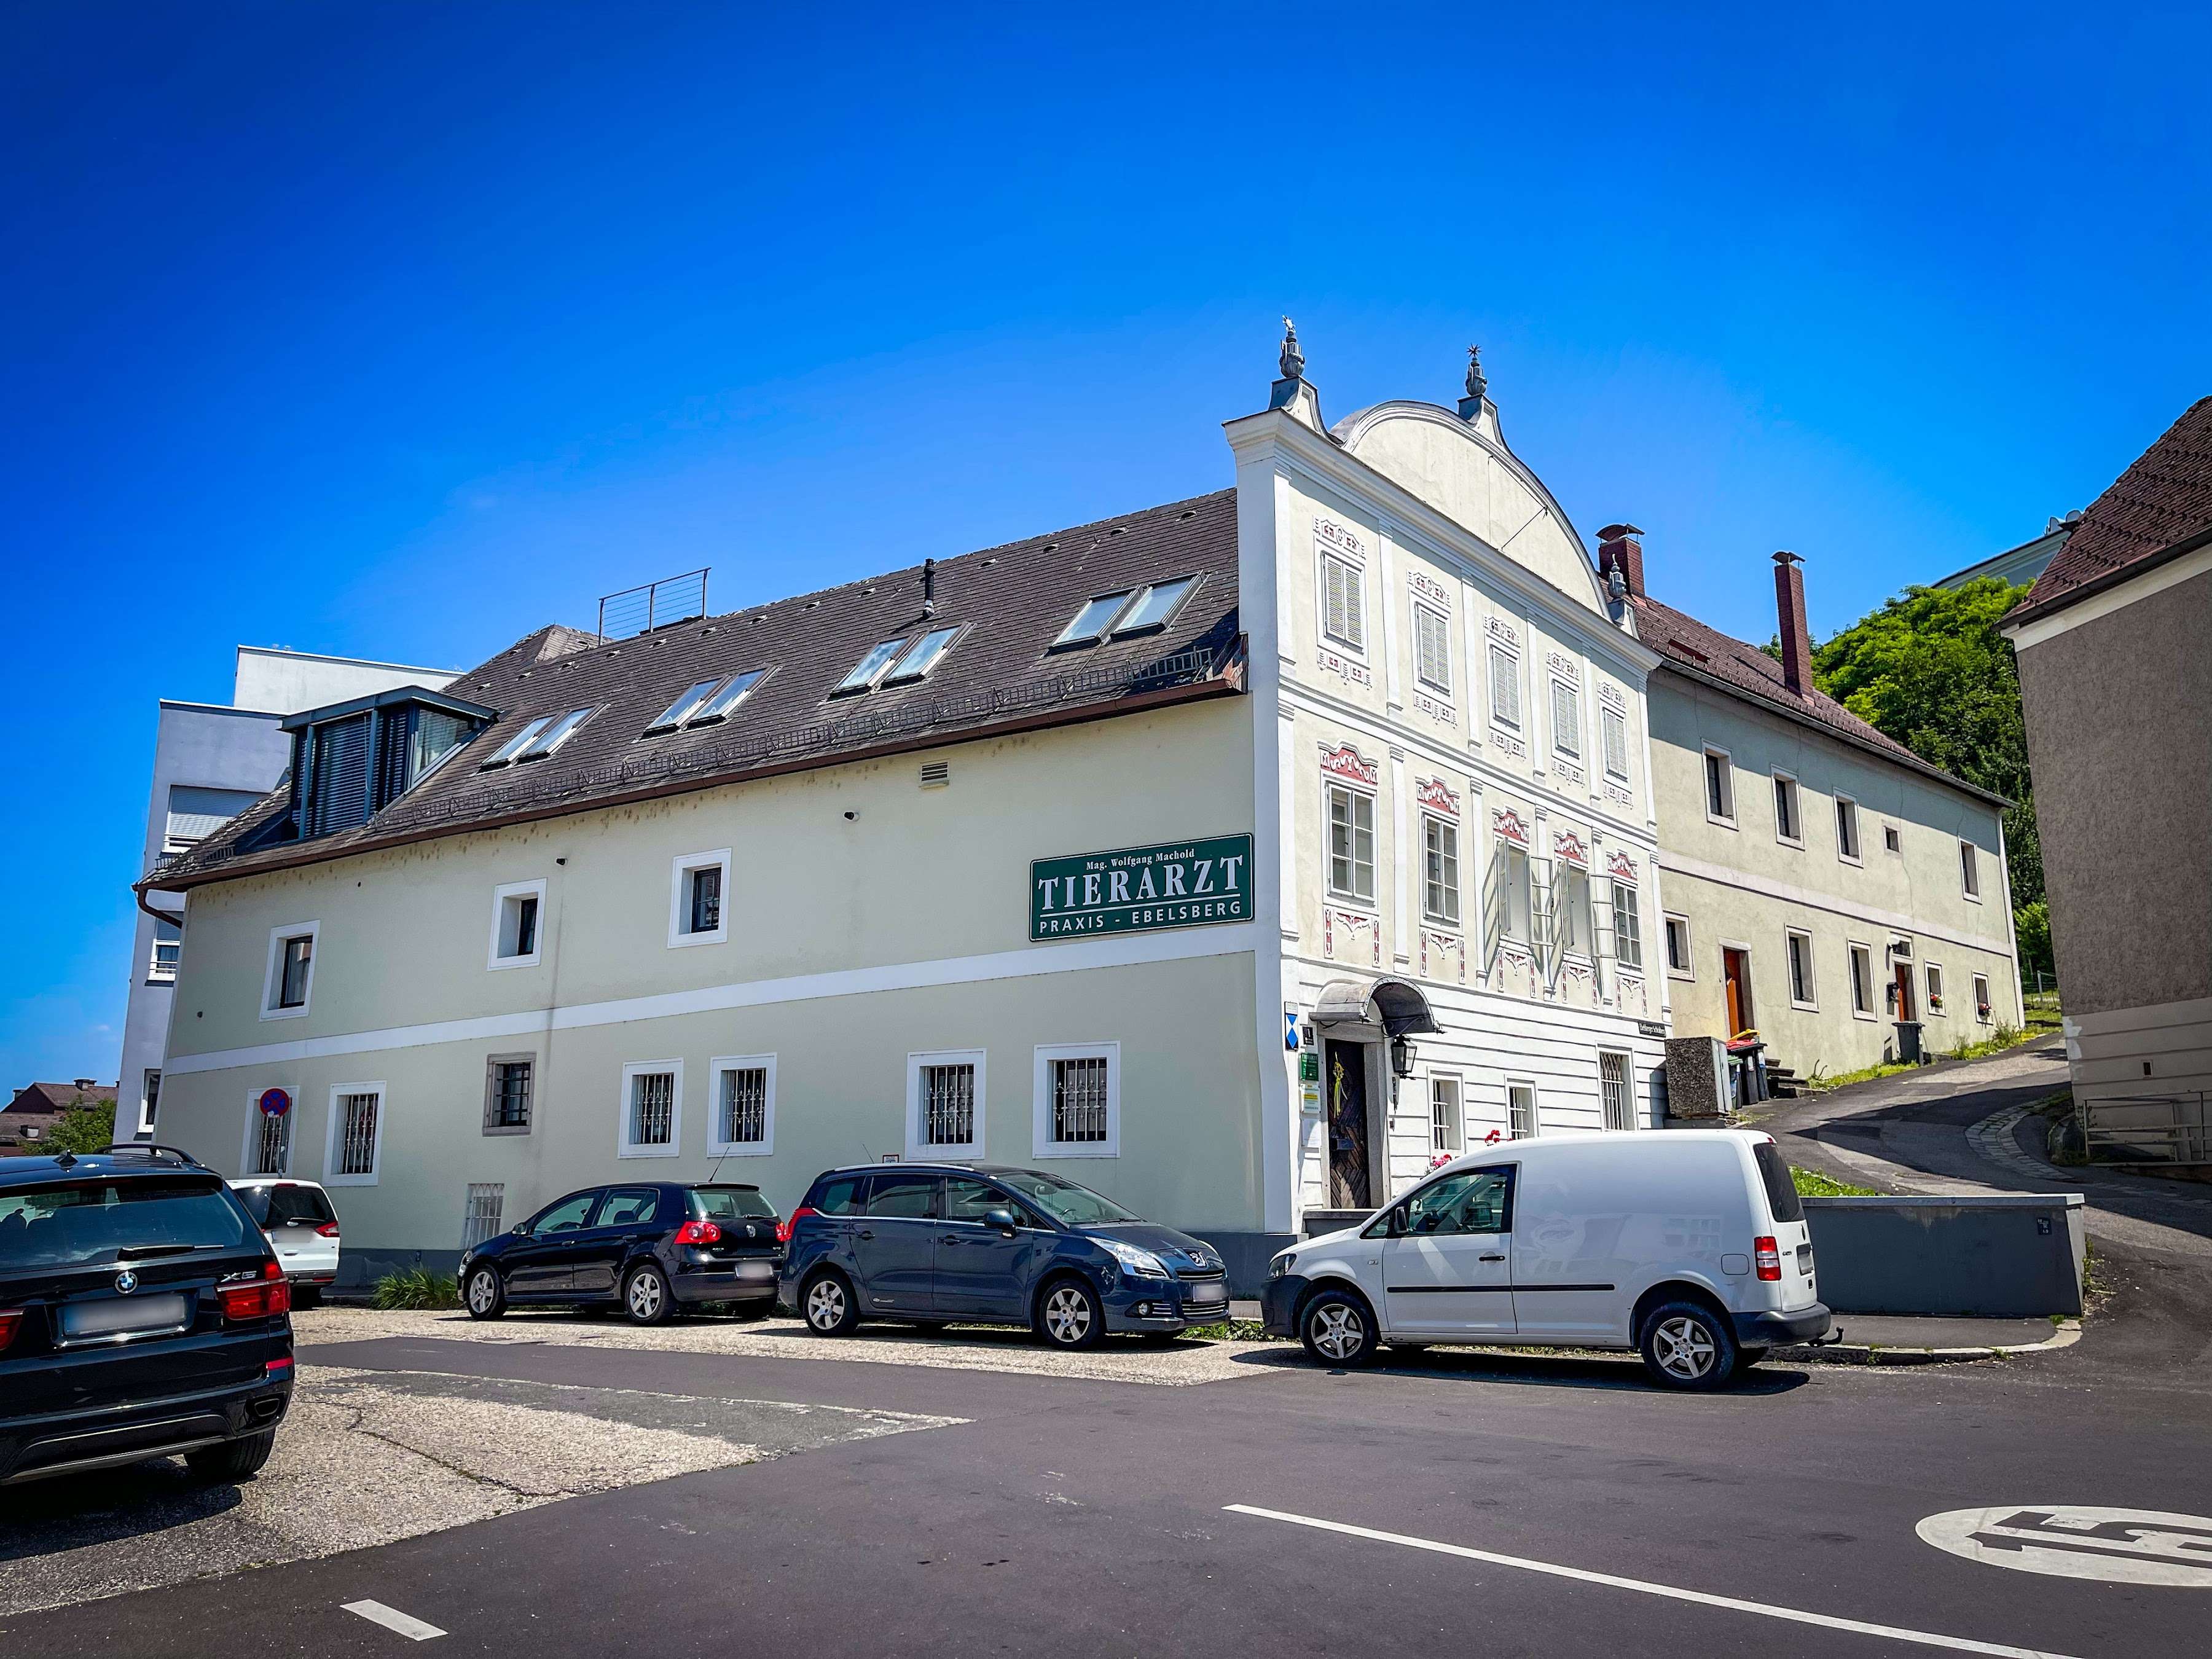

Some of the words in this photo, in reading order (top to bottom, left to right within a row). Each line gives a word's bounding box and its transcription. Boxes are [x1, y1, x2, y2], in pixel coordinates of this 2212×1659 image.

[1086, 861, 1107, 871] Mag.
[1111, 855, 1153, 868] Wolfgang
[1155, 849, 1194, 862] Machold
[1038, 855, 1243, 910] TIERARZT
[1040, 915, 1104, 933] PRAXIS
[1132, 901, 1241, 924] EBELSBERG
[221, 1271, 257, 1282] X5
